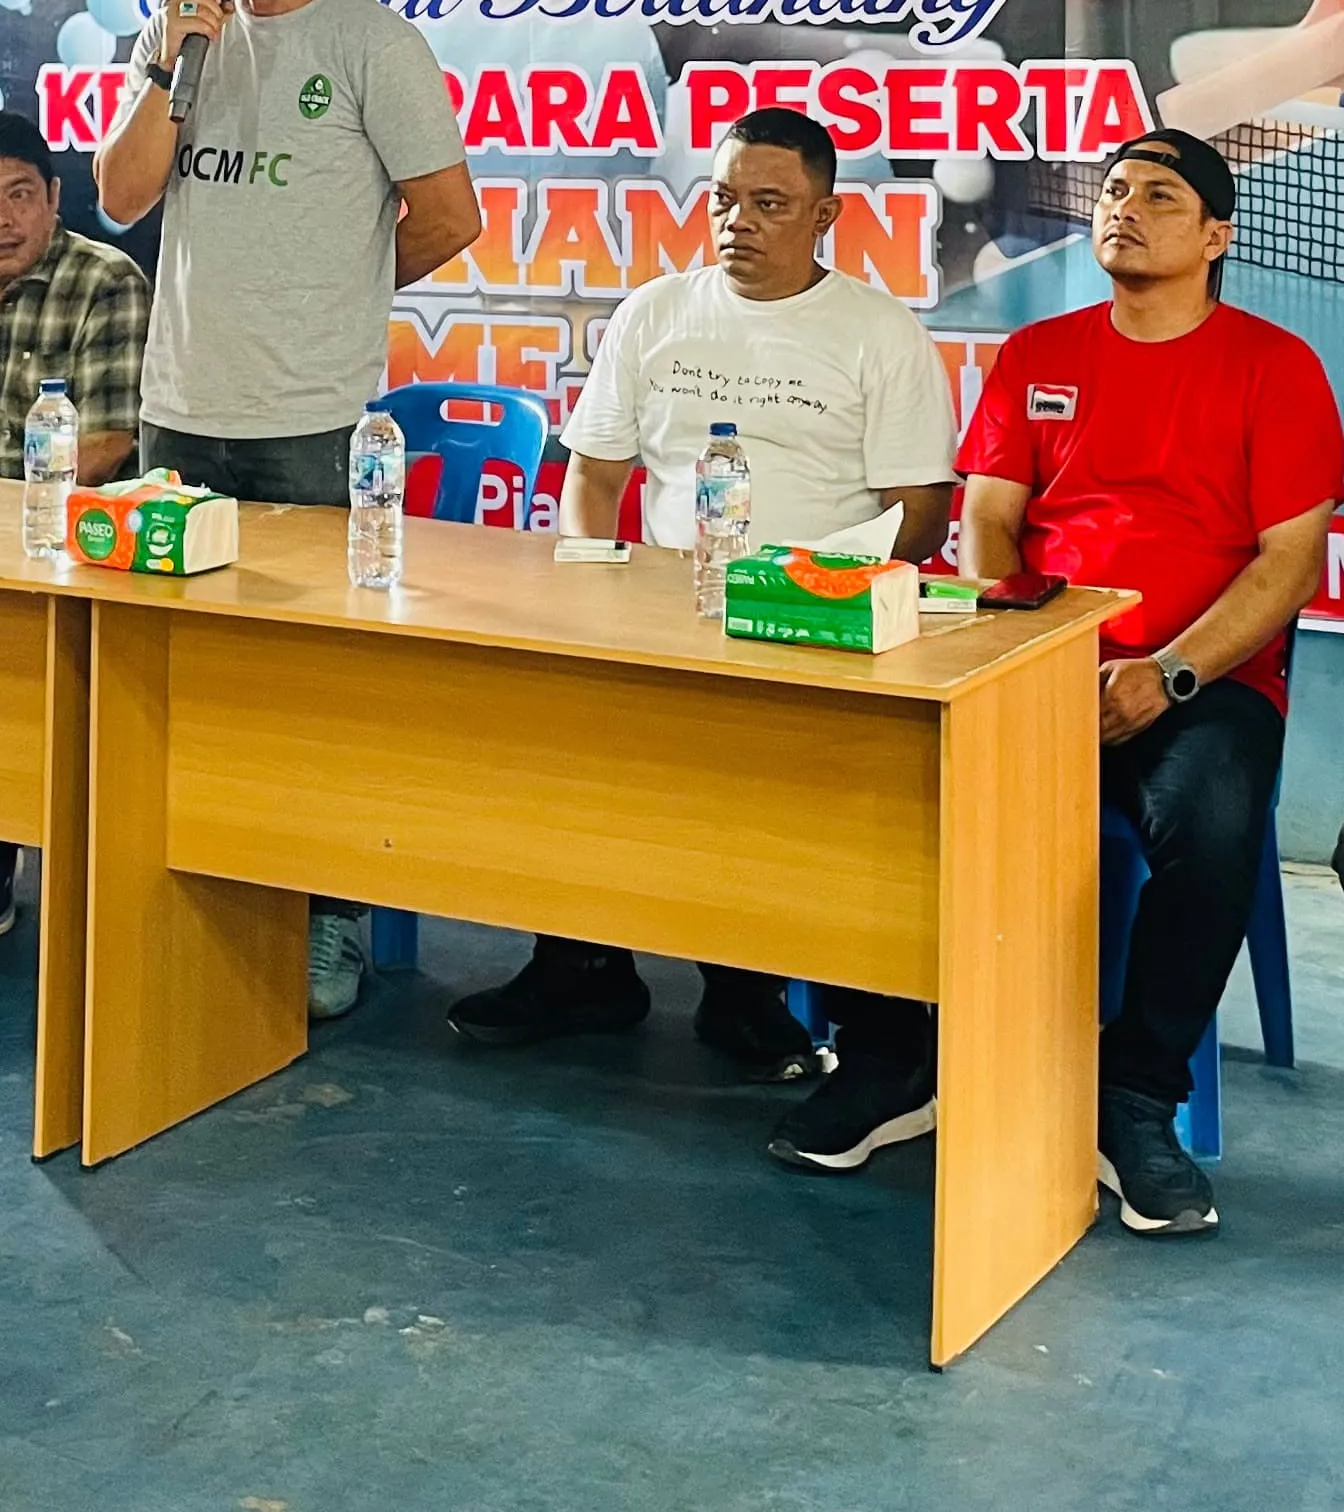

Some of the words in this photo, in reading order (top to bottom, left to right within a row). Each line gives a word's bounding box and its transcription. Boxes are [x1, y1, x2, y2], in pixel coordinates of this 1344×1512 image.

[178, 143, 245, 185] OCM
[248, 150, 293, 188] FC
[708, 369, 731, 388] try
[710, 391, 729, 403] do
[733, 394, 744, 405] it
[749, 394, 782, 408] right
[474, 472, 560, 534] Pia
[78, 520, 114, 539] PASEO
